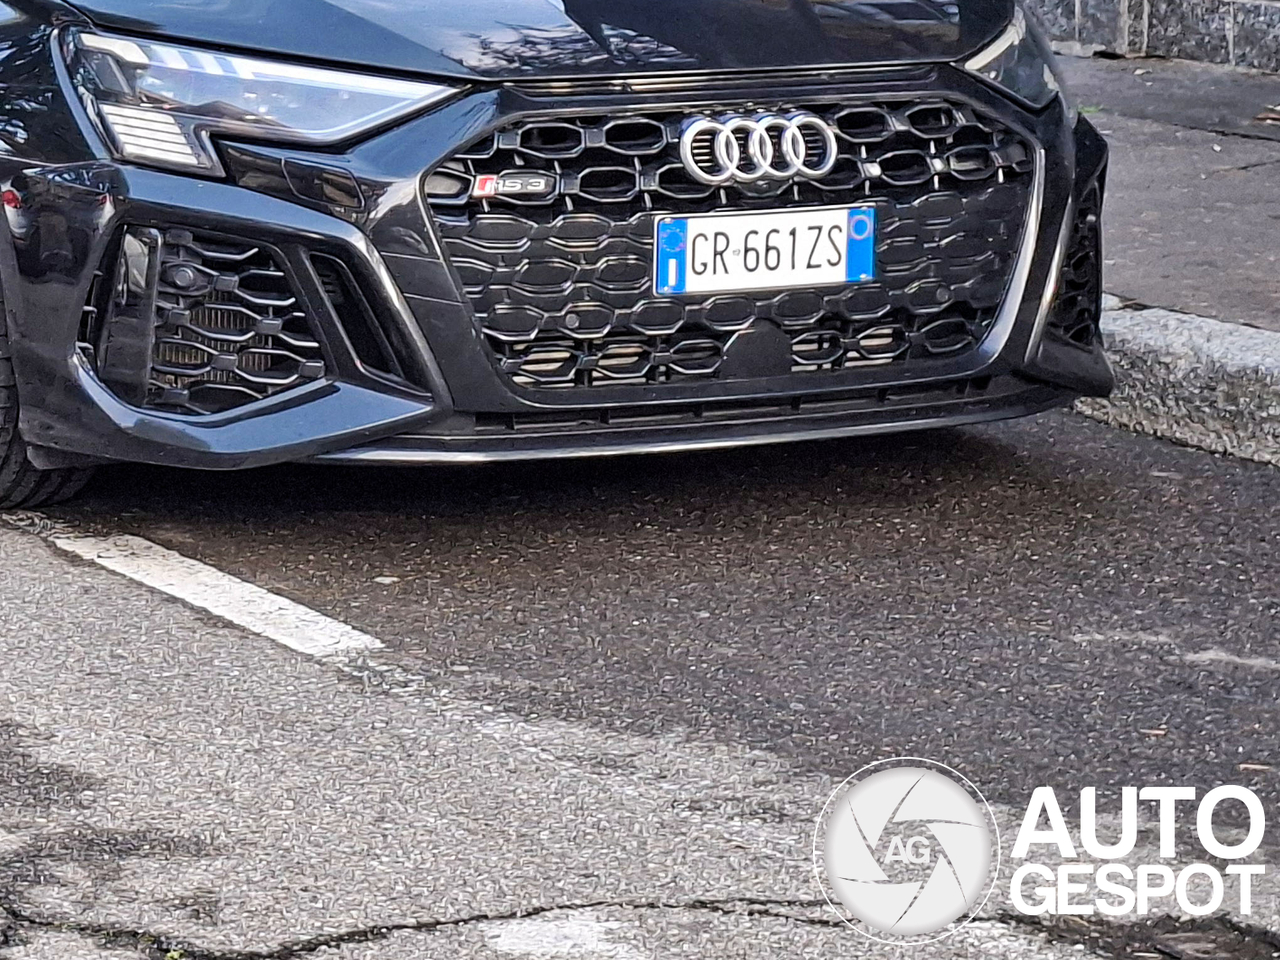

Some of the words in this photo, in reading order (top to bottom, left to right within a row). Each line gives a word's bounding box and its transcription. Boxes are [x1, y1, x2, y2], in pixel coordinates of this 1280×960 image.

[527, 178, 545, 191] 3
[691, 231, 730, 276] GR
[743, 224, 843, 272] 661ZS
